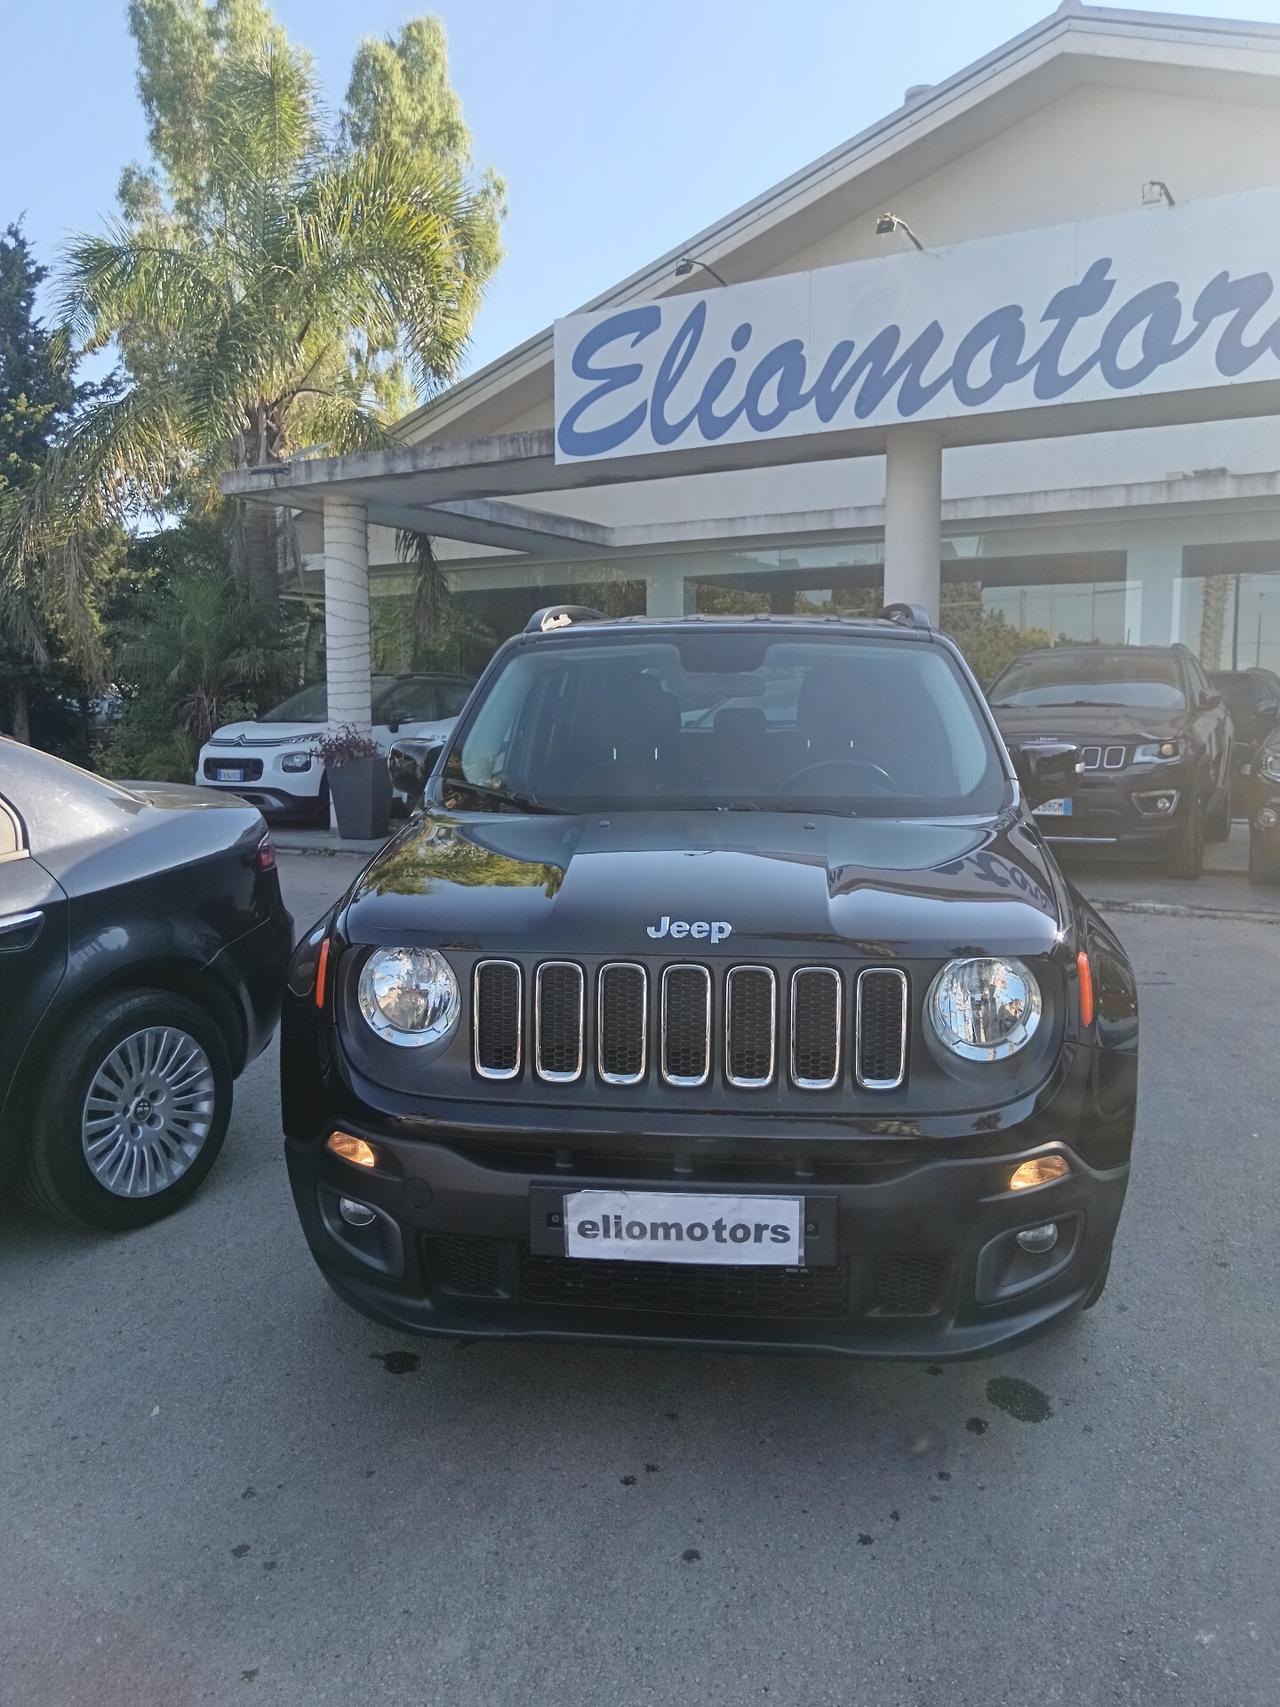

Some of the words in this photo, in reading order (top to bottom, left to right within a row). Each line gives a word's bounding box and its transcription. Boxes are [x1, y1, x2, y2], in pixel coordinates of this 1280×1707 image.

[557, 257, 1280, 456] Eliomotor
[646, 916, 732, 943] Jeep
[577, 1214, 791, 1244] eliomotors
